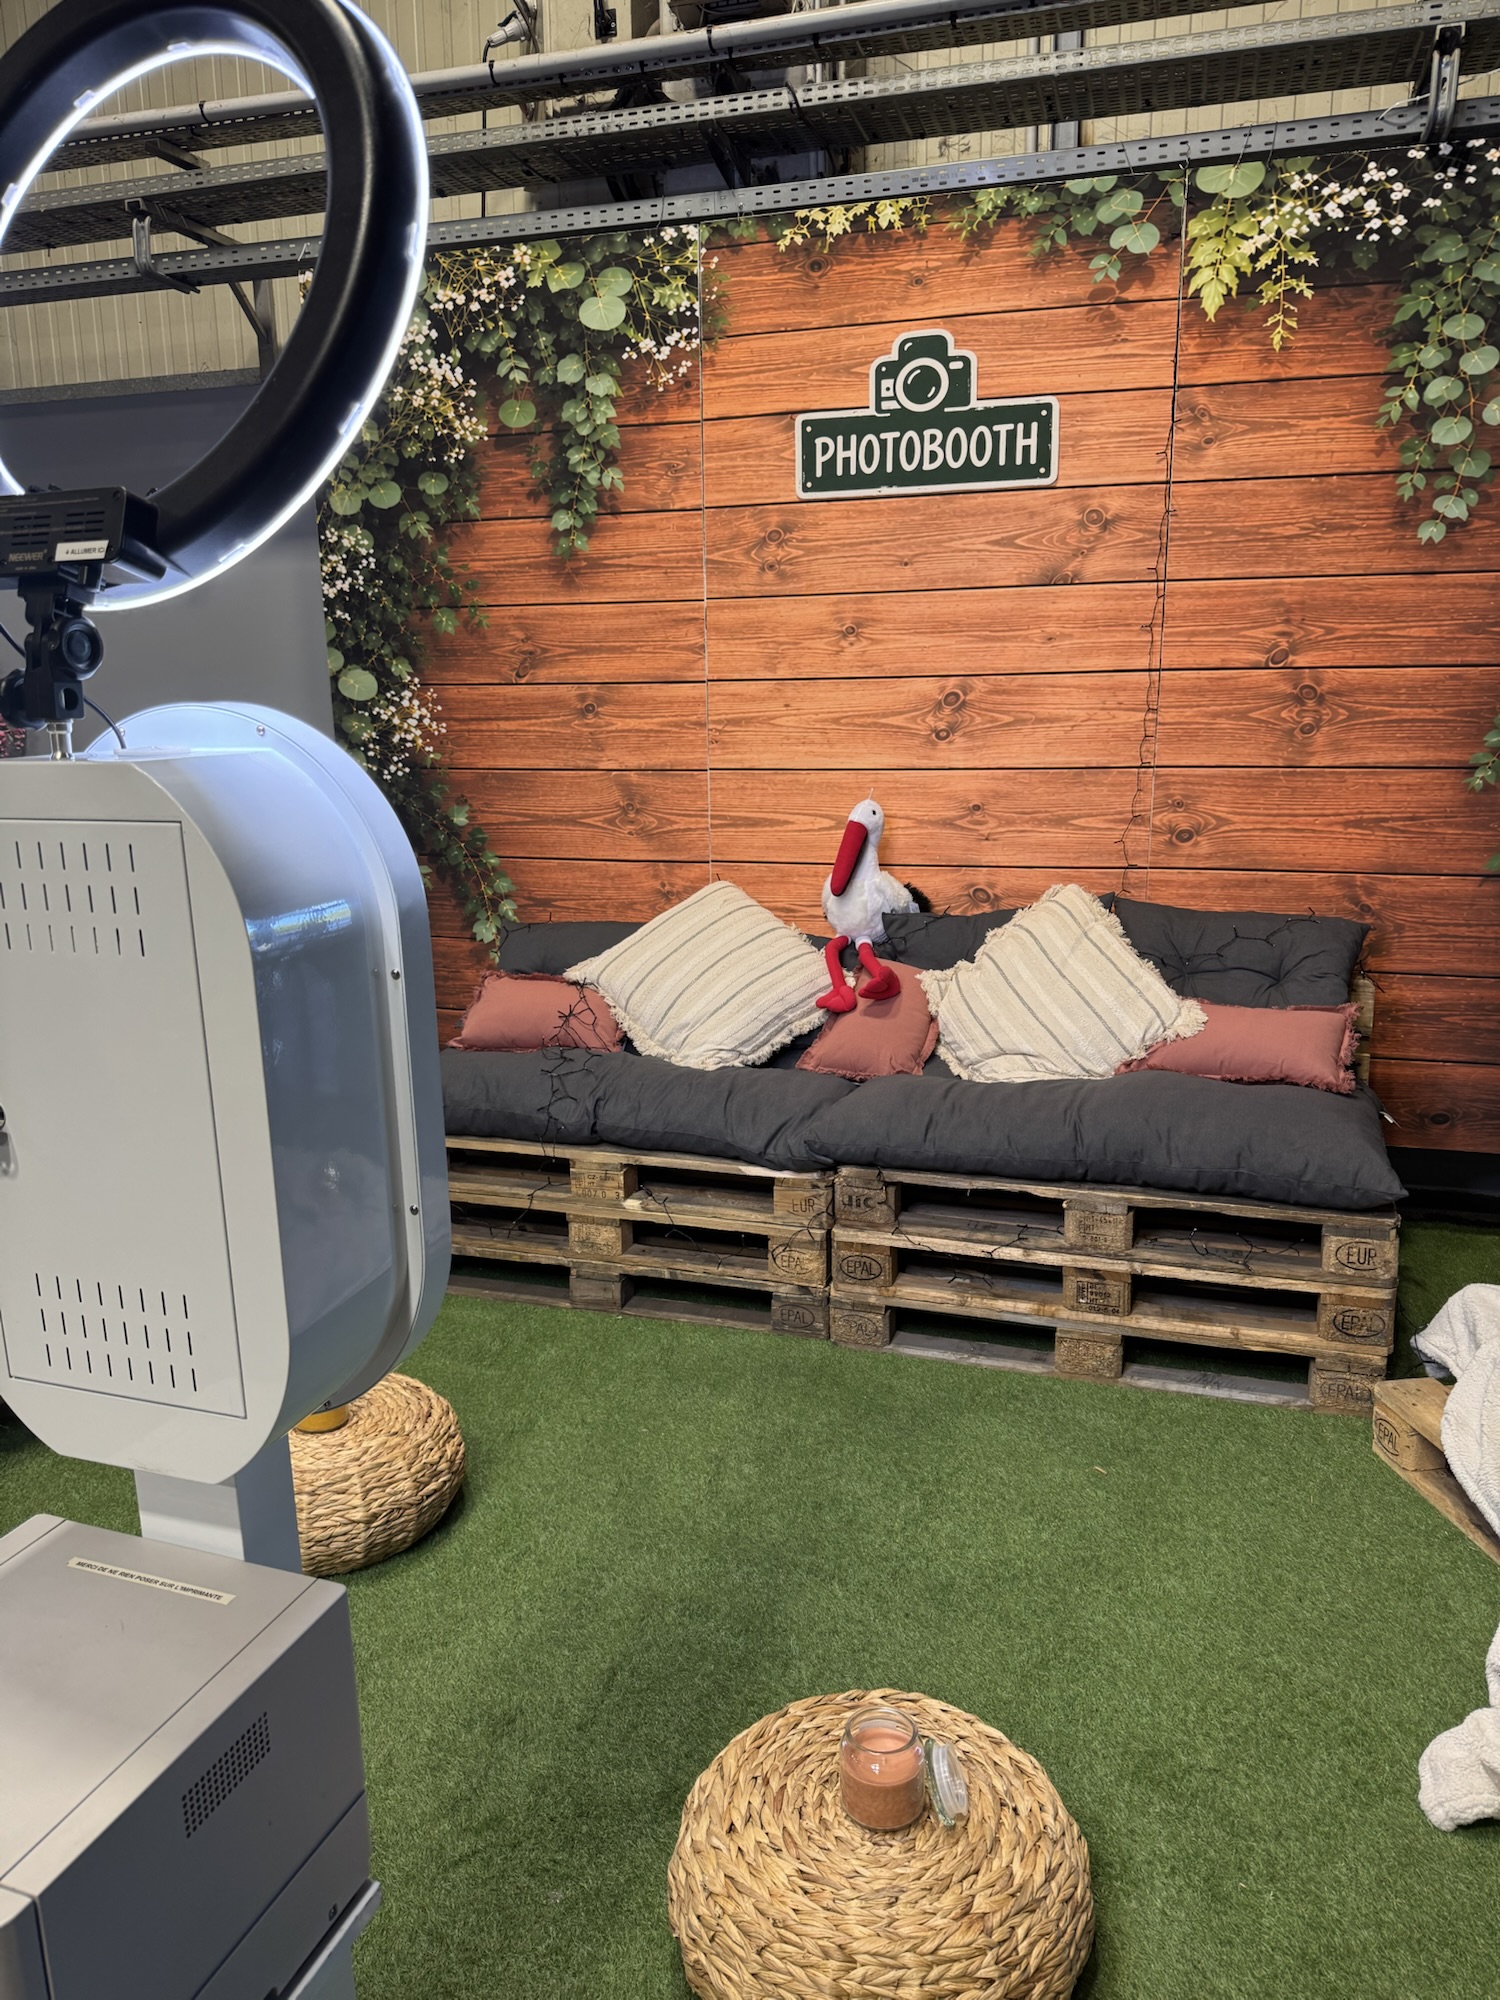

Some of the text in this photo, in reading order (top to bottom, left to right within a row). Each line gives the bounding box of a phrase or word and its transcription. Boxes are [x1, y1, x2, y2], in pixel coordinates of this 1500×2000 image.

[814, 421, 1039, 478] PHOTOBOOTH
[8, 551, 43, 562] NEEWER
[70, 547, 97, 555] ALLUMER
[792, 1198, 815, 1213] EUR
[780, 1254, 810, 1271] EPAL
[1346, 1247, 1377, 1266] EUR
[846, 1260, 877, 1277] EPAL
[780, 1310, 809, 1322] EPAL
[1341, 1314, 1378, 1333] EPAL
[1327, 1382, 1364, 1401] EPAL
[1377, 1422, 1400, 1454] EPAL
[76, 1561, 99, 1570] MERCI
[118, 1571, 137, 1579] RIEN
[134, 1575, 160, 1584] POSER
[159, 1581, 175, 1589] SUR
